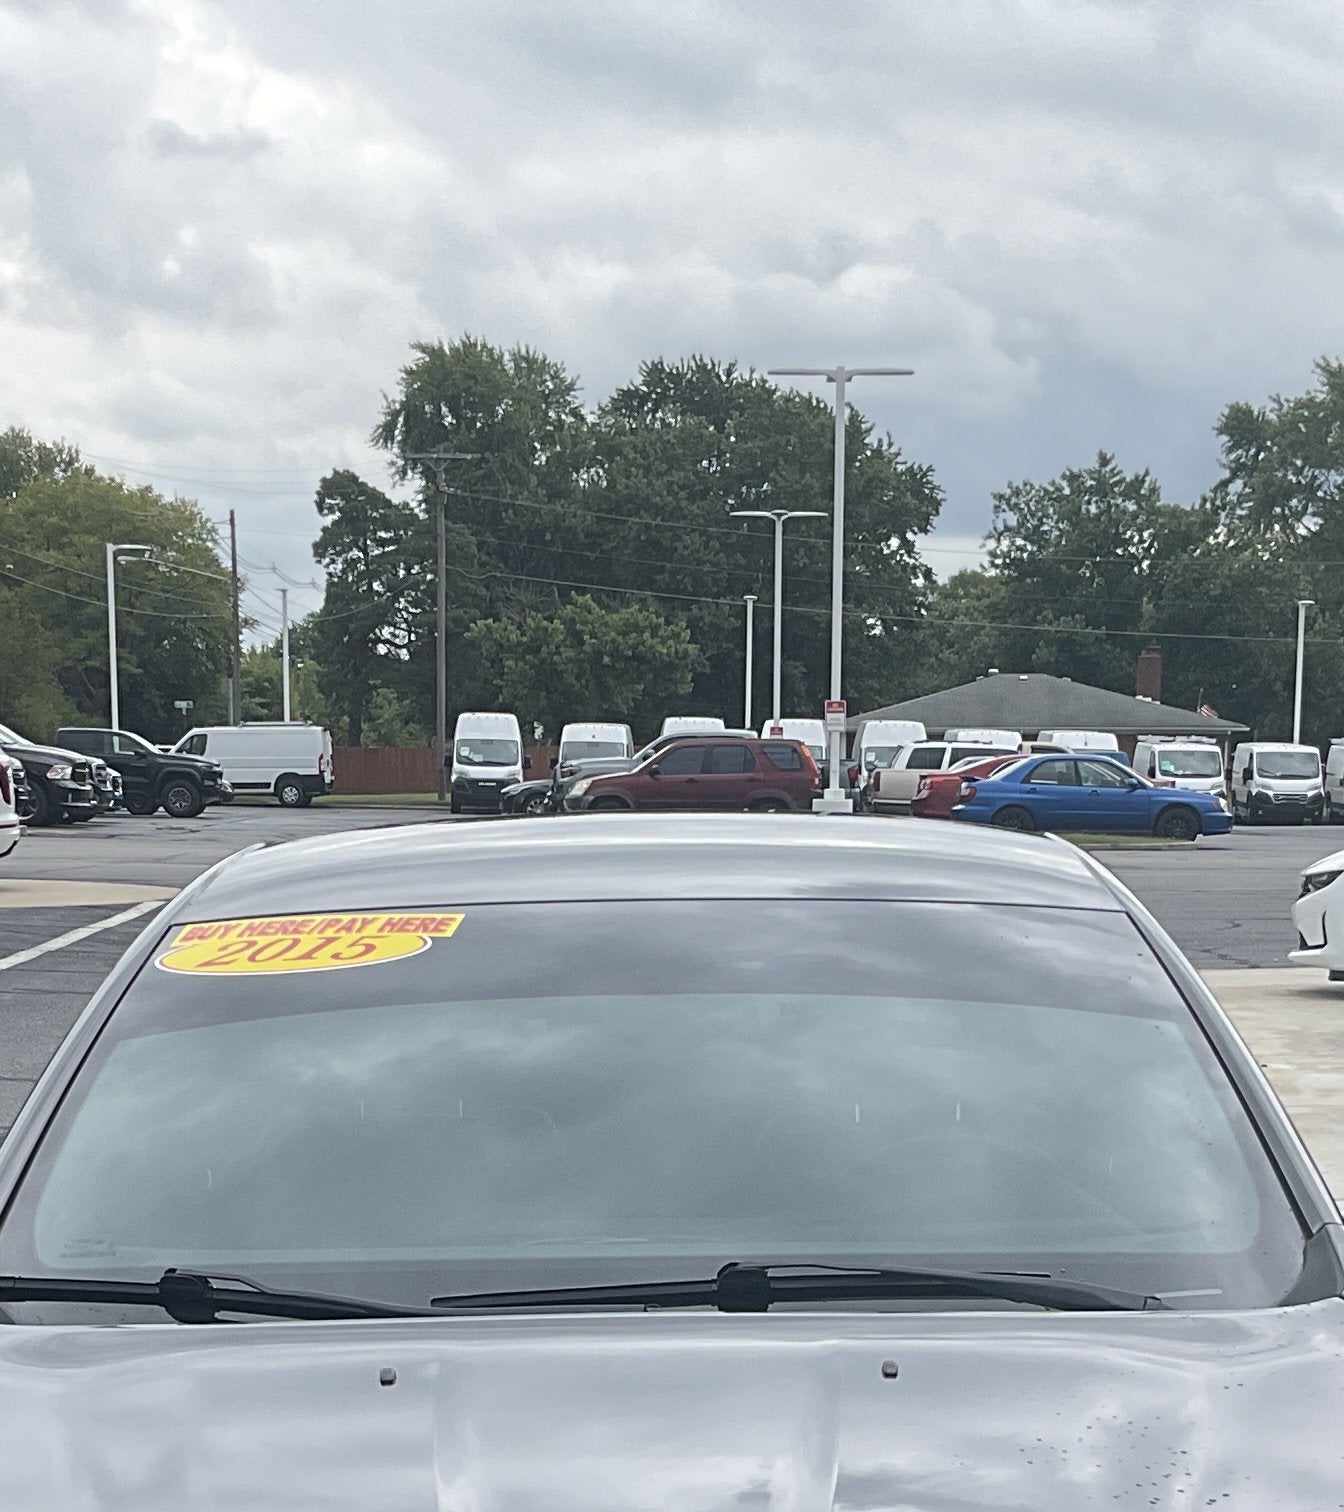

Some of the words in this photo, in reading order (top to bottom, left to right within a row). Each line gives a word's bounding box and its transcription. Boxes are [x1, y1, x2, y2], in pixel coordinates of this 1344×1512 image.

[179, 922, 243, 942] BUY
[236, 918, 381, 937] HERE/PAY
[376, 916, 457, 934] HERE
[195, 936, 388, 968] 2015
